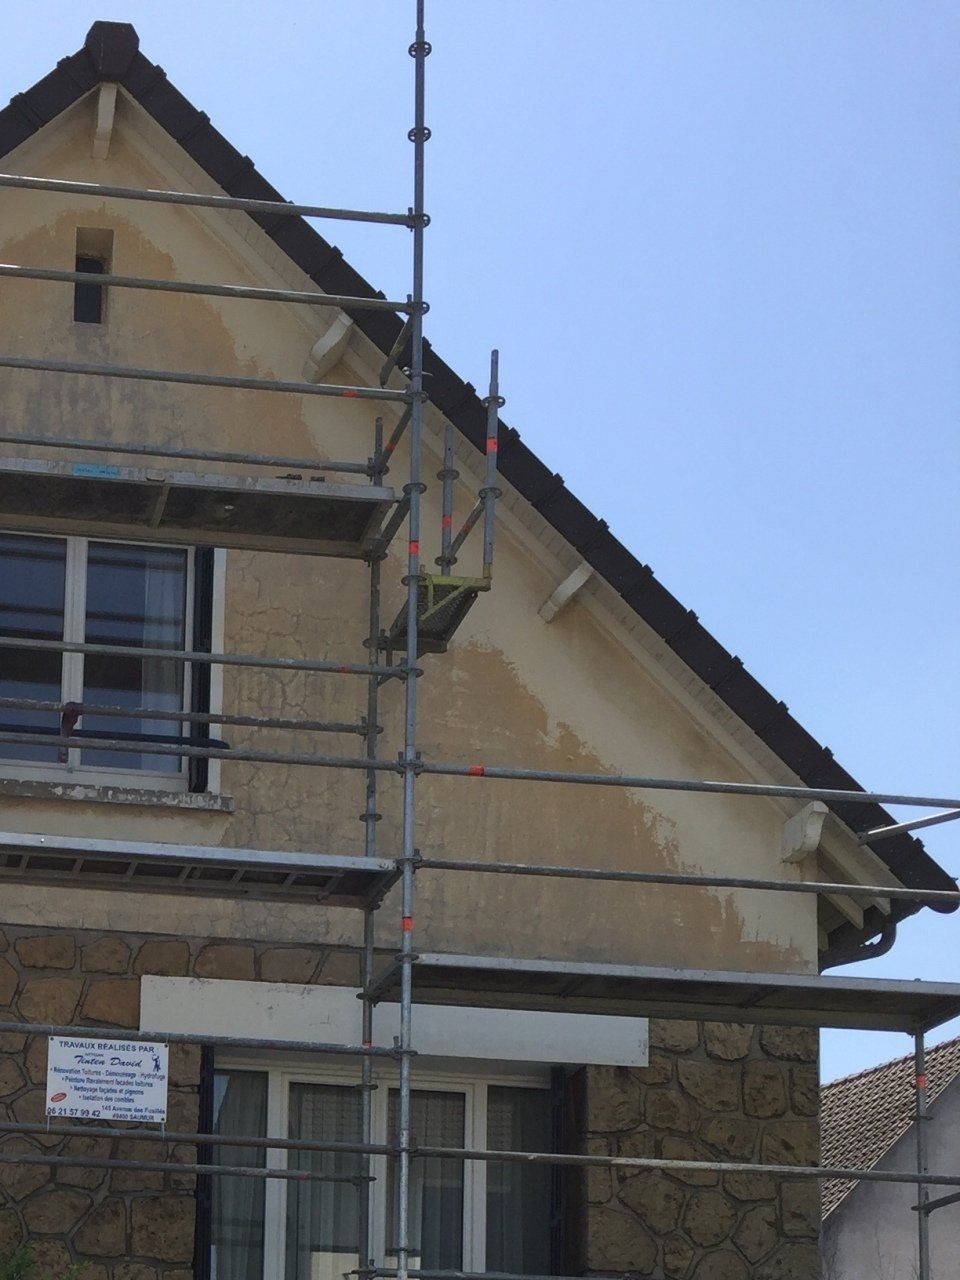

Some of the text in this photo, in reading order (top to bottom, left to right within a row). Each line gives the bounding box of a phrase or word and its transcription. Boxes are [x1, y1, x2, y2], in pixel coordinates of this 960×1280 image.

[59, 1041, 95, 1049] TRAVAUX
[110, 1057, 143, 1067] David
[58, 1107, 67, 1116] 21
[69, 1108, 78, 1116] 57
[91, 1109, 101, 1118] 42
